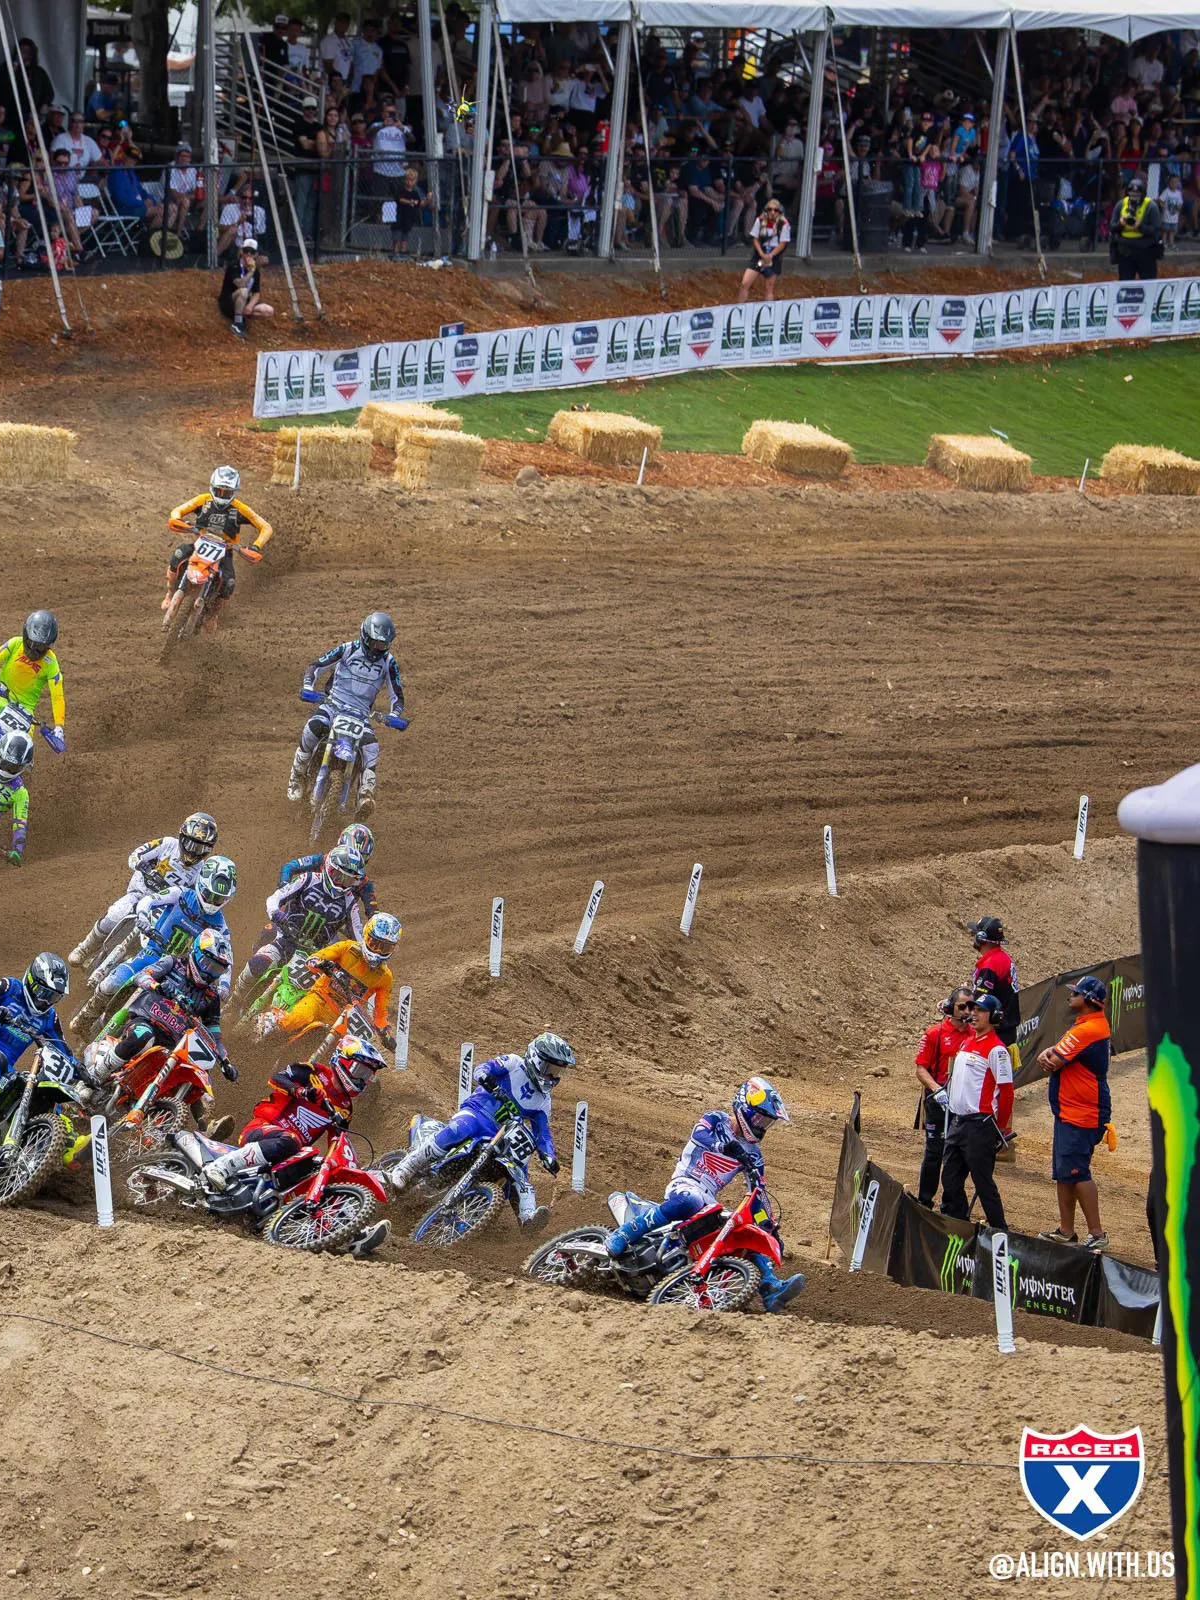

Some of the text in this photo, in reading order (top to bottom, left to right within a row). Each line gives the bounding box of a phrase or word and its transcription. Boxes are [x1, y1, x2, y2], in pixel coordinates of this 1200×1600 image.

[197, 543, 222, 561] 671
[349, 659, 383, 675] FXR
[334, 719, 363, 735] 210
[150, 1002, 169, 1022] Red
[188, 1038, 215, 1062] 7
[46, 1054, 73, 1083] 31
[288, 1113, 312, 1142] HONDA
[96, 1138, 105, 1175] UFO
[507, 1129, 535, 1161] 38
[995, 1259, 1004, 1295] UFO
[1019, 1275, 1076, 1305] MONSTER
[1026, 1300, 1069, 1315] ENERGY
